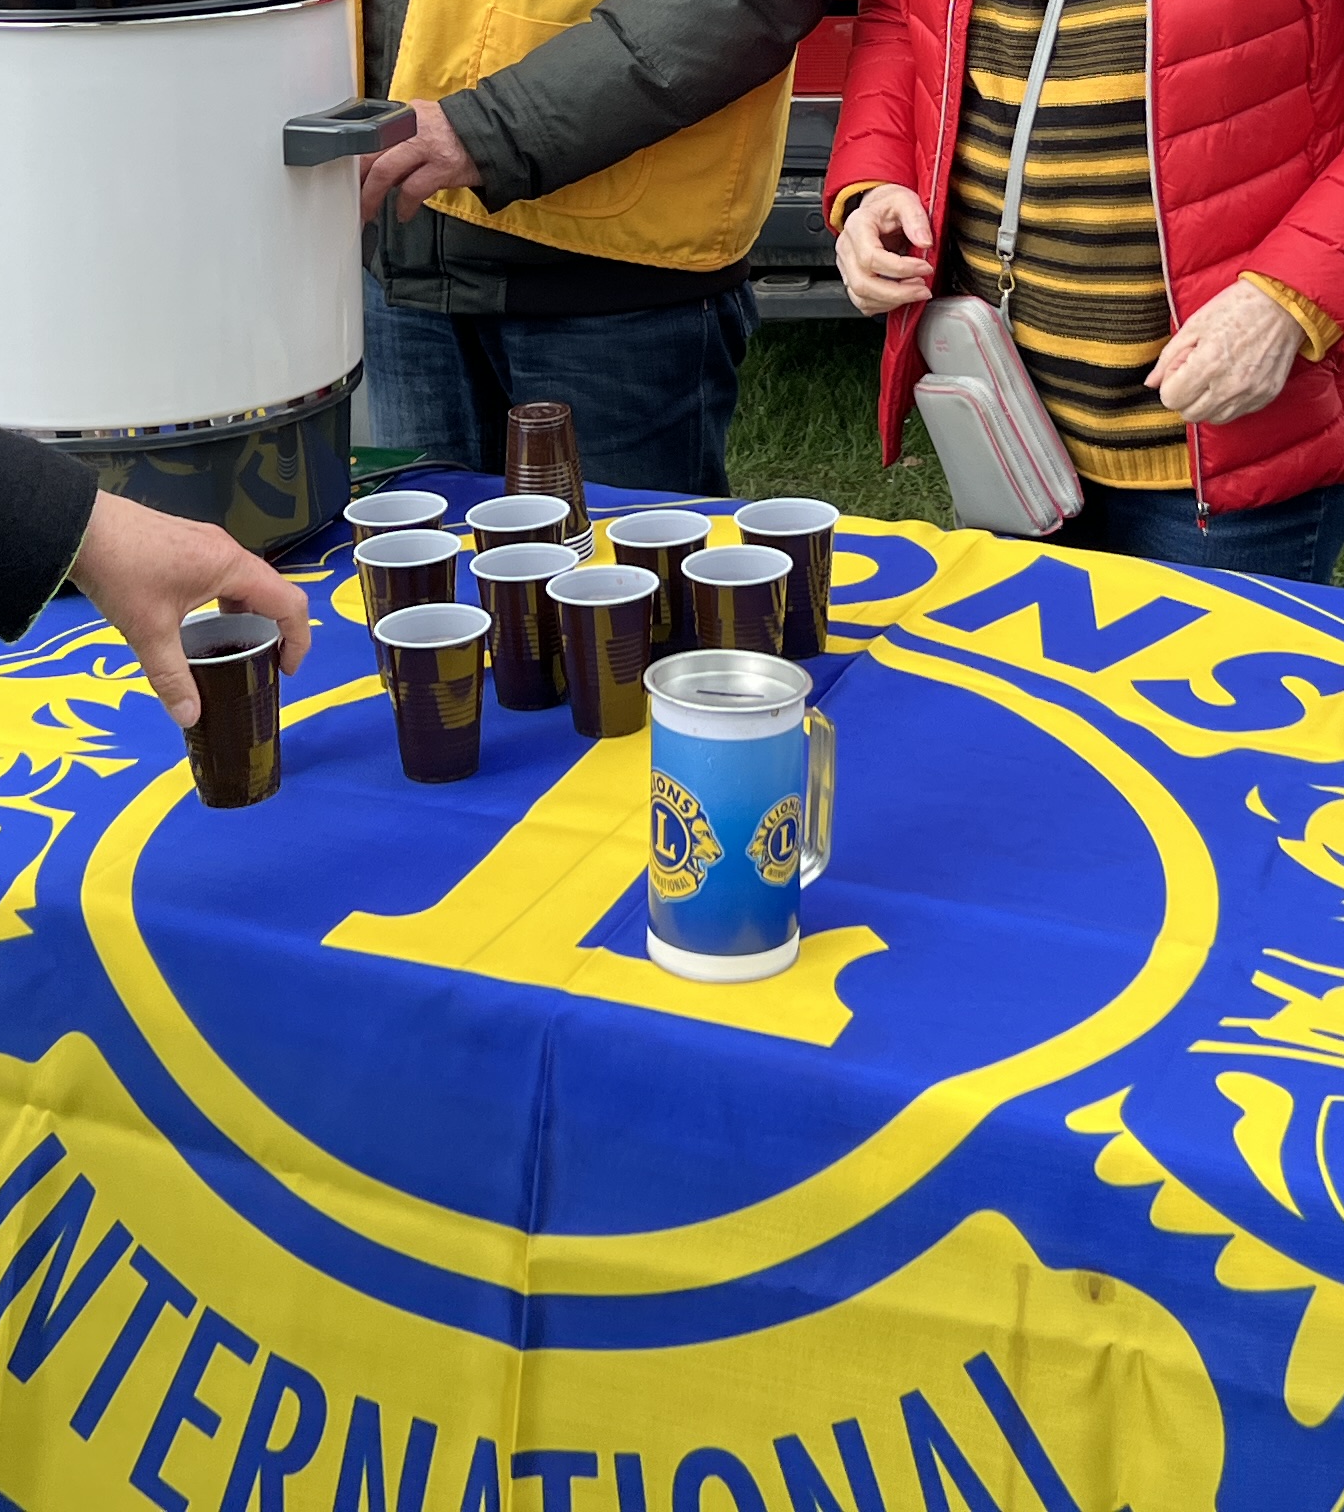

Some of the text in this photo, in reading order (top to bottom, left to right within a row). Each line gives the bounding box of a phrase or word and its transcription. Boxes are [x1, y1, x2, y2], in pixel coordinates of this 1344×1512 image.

[651, 775, 693, 816] IONS
[655, 807, 677, 862] L
[779, 823, 793, 857] L
